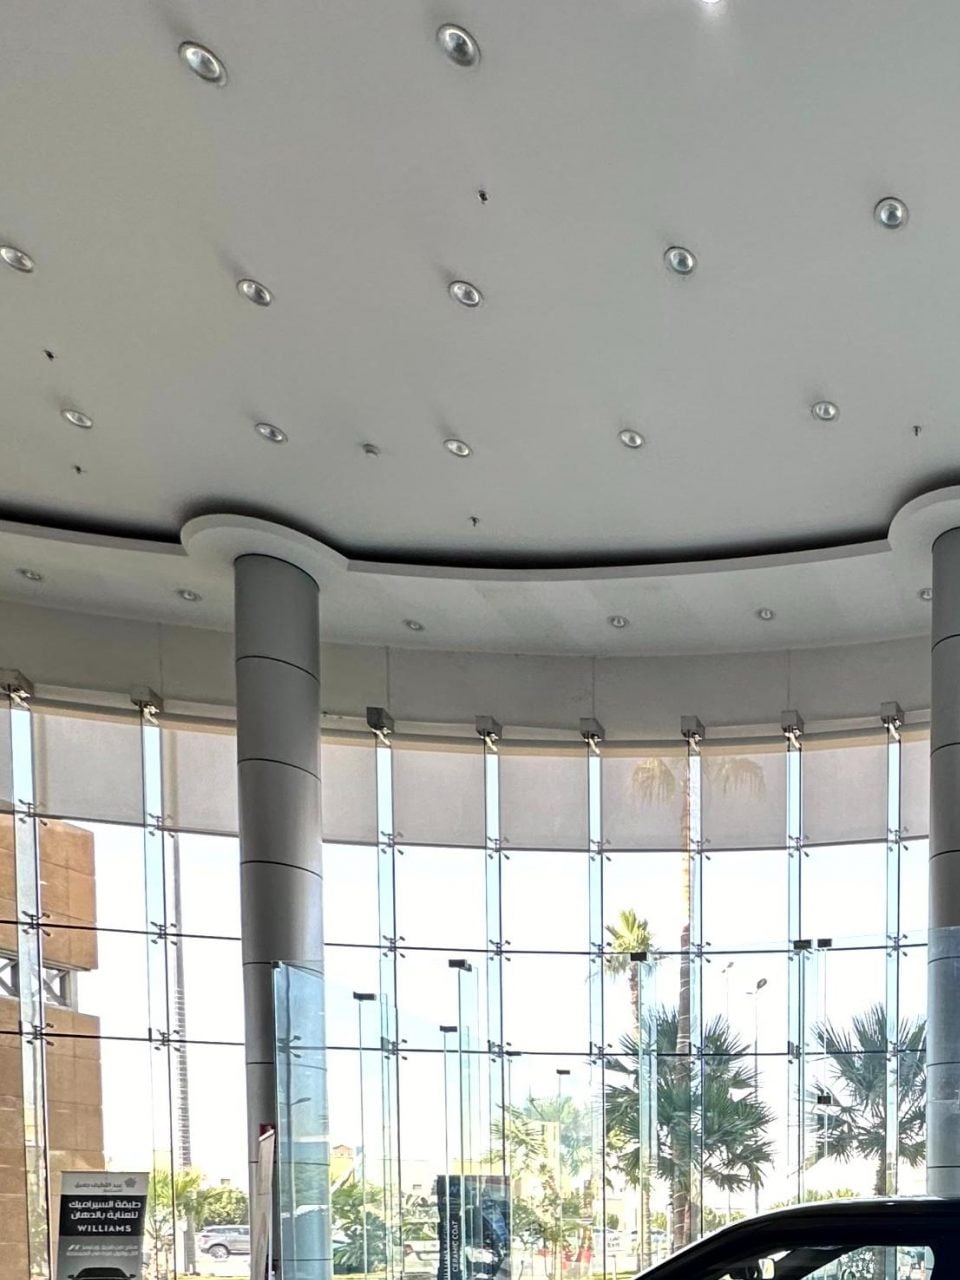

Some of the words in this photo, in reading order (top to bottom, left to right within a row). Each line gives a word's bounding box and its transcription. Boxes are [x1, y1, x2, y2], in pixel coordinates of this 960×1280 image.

[69, 1200, 114, 1209] السيراميك
[115, 1200, 141, 1209] طبقة
[71, 1210, 106, 1220] بالدهان
[107, 1210, 139, 1220] للعناية
